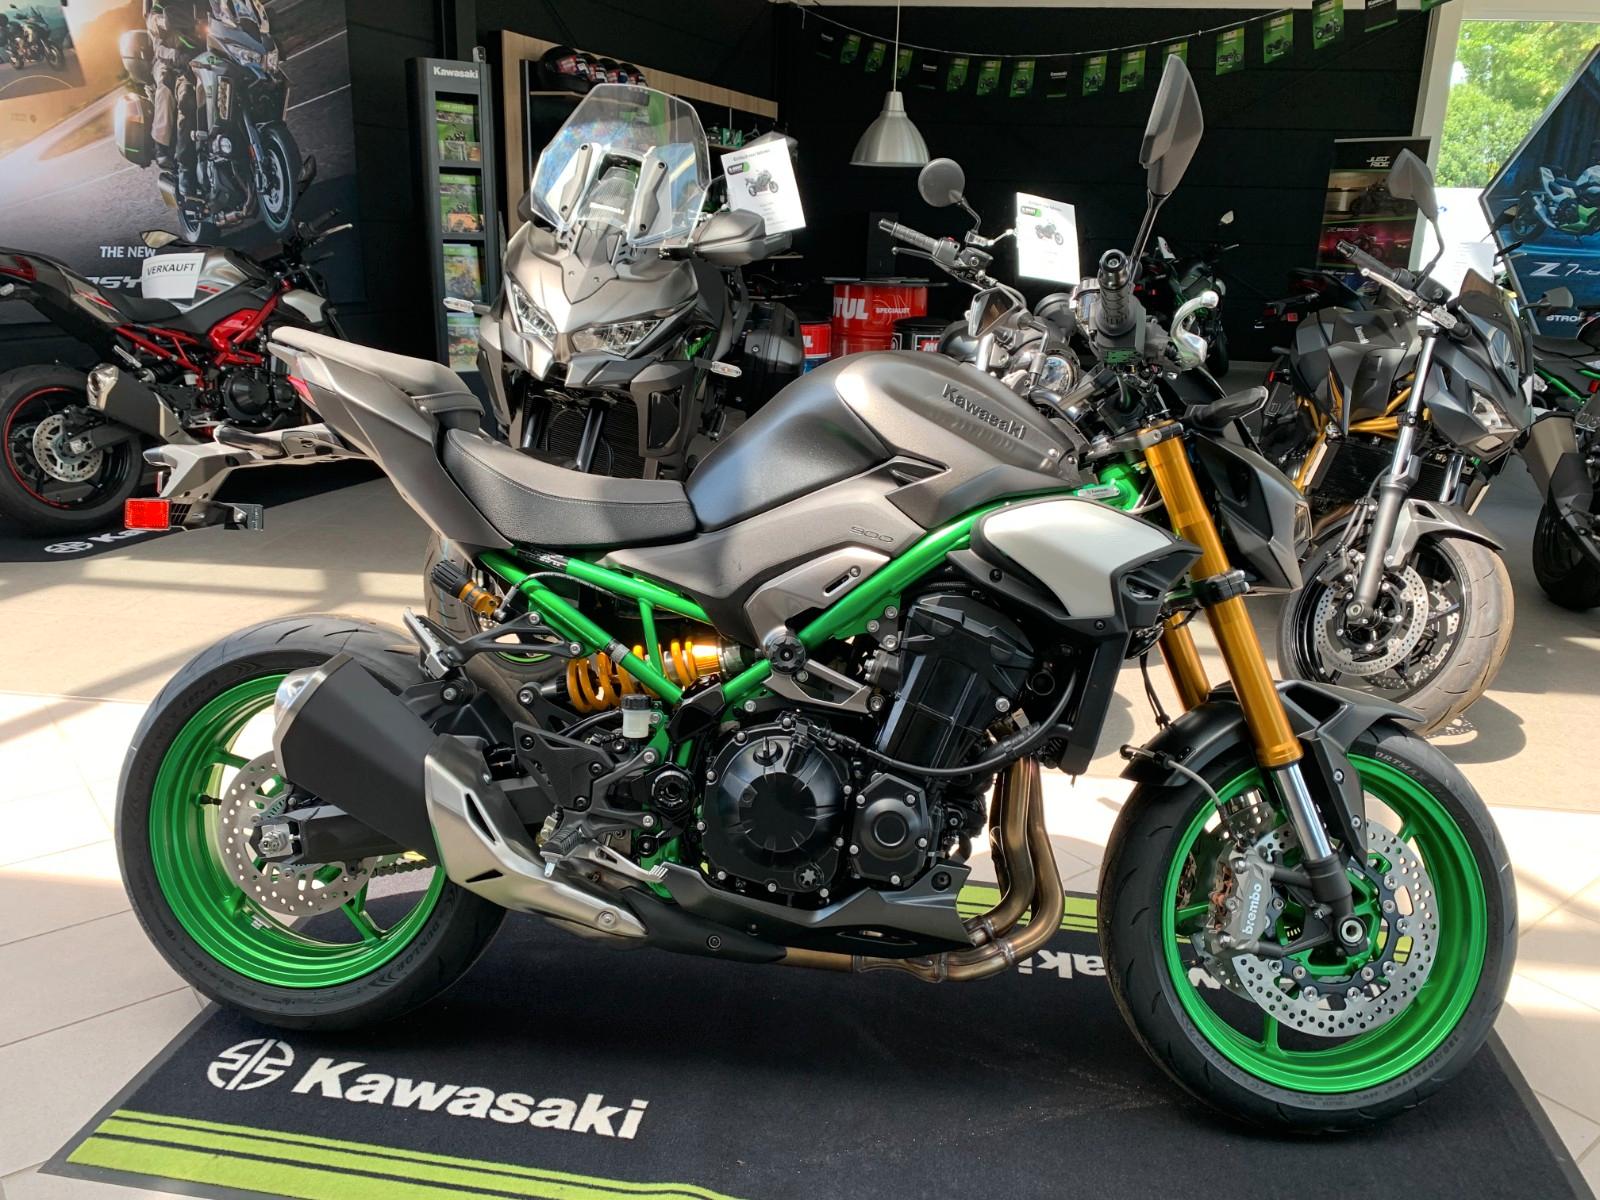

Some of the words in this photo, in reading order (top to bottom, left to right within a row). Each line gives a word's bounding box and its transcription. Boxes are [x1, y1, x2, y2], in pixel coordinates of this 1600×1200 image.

[433, 66, 479, 79] Kawasaki
[100, 246, 125, 258] THE
[146, 262, 196, 276] VERKAUFT
[875, 307, 911, 315] SPECIALIST
[942, 383, 1027, 441] Kawasaki
[850, 526, 894, 543] 900
[1242, 883, 1262, 935] brembo
[291, 1057, 649, 1139] Kawasaki
